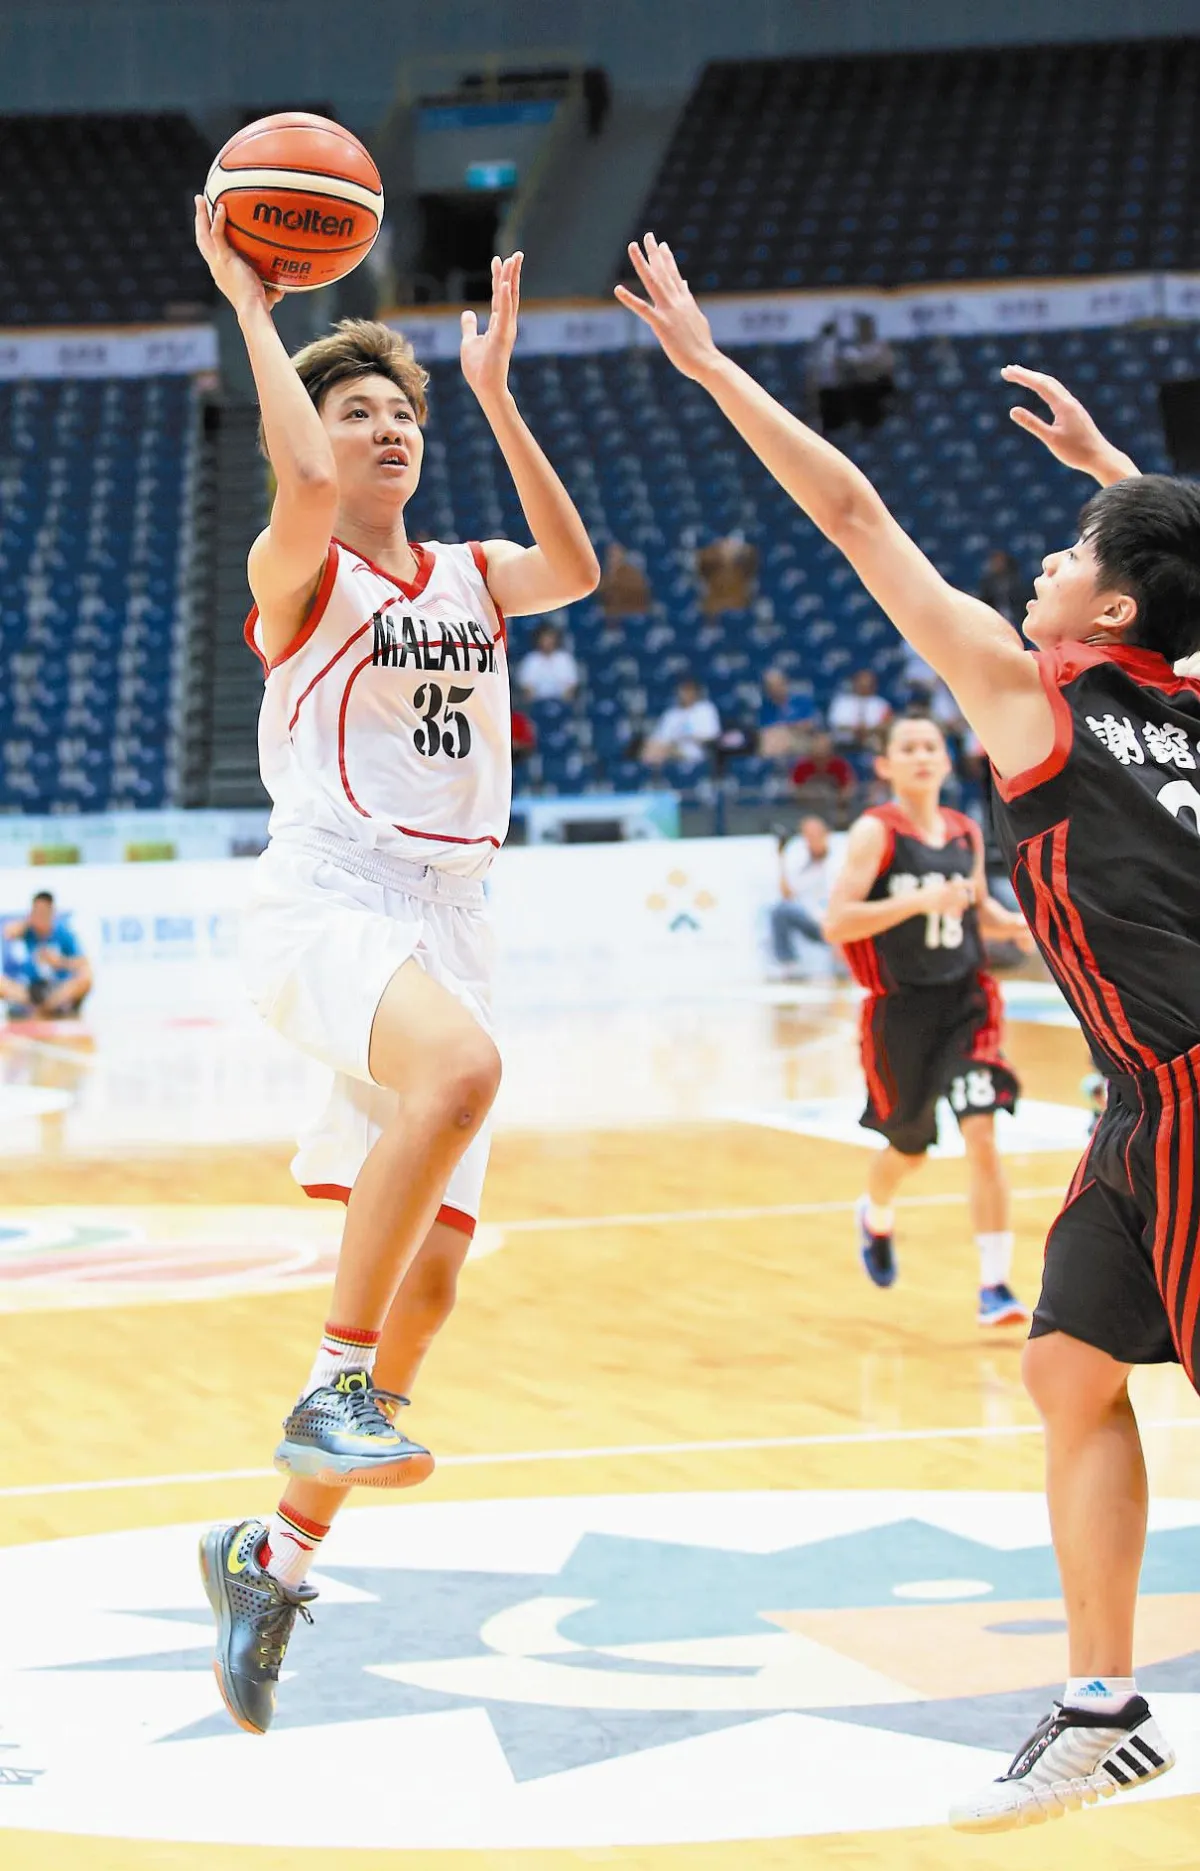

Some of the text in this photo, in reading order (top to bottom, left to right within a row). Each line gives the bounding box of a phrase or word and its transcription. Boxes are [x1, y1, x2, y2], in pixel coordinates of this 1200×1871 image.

[252, 202, 355, 237] molten
[271, 256, 312, 274] FIBA
[372, 612, 499, 675] MALAYSI
[413, 682, 475, 759] 35
[952, 1069, 996, 1112] 18
